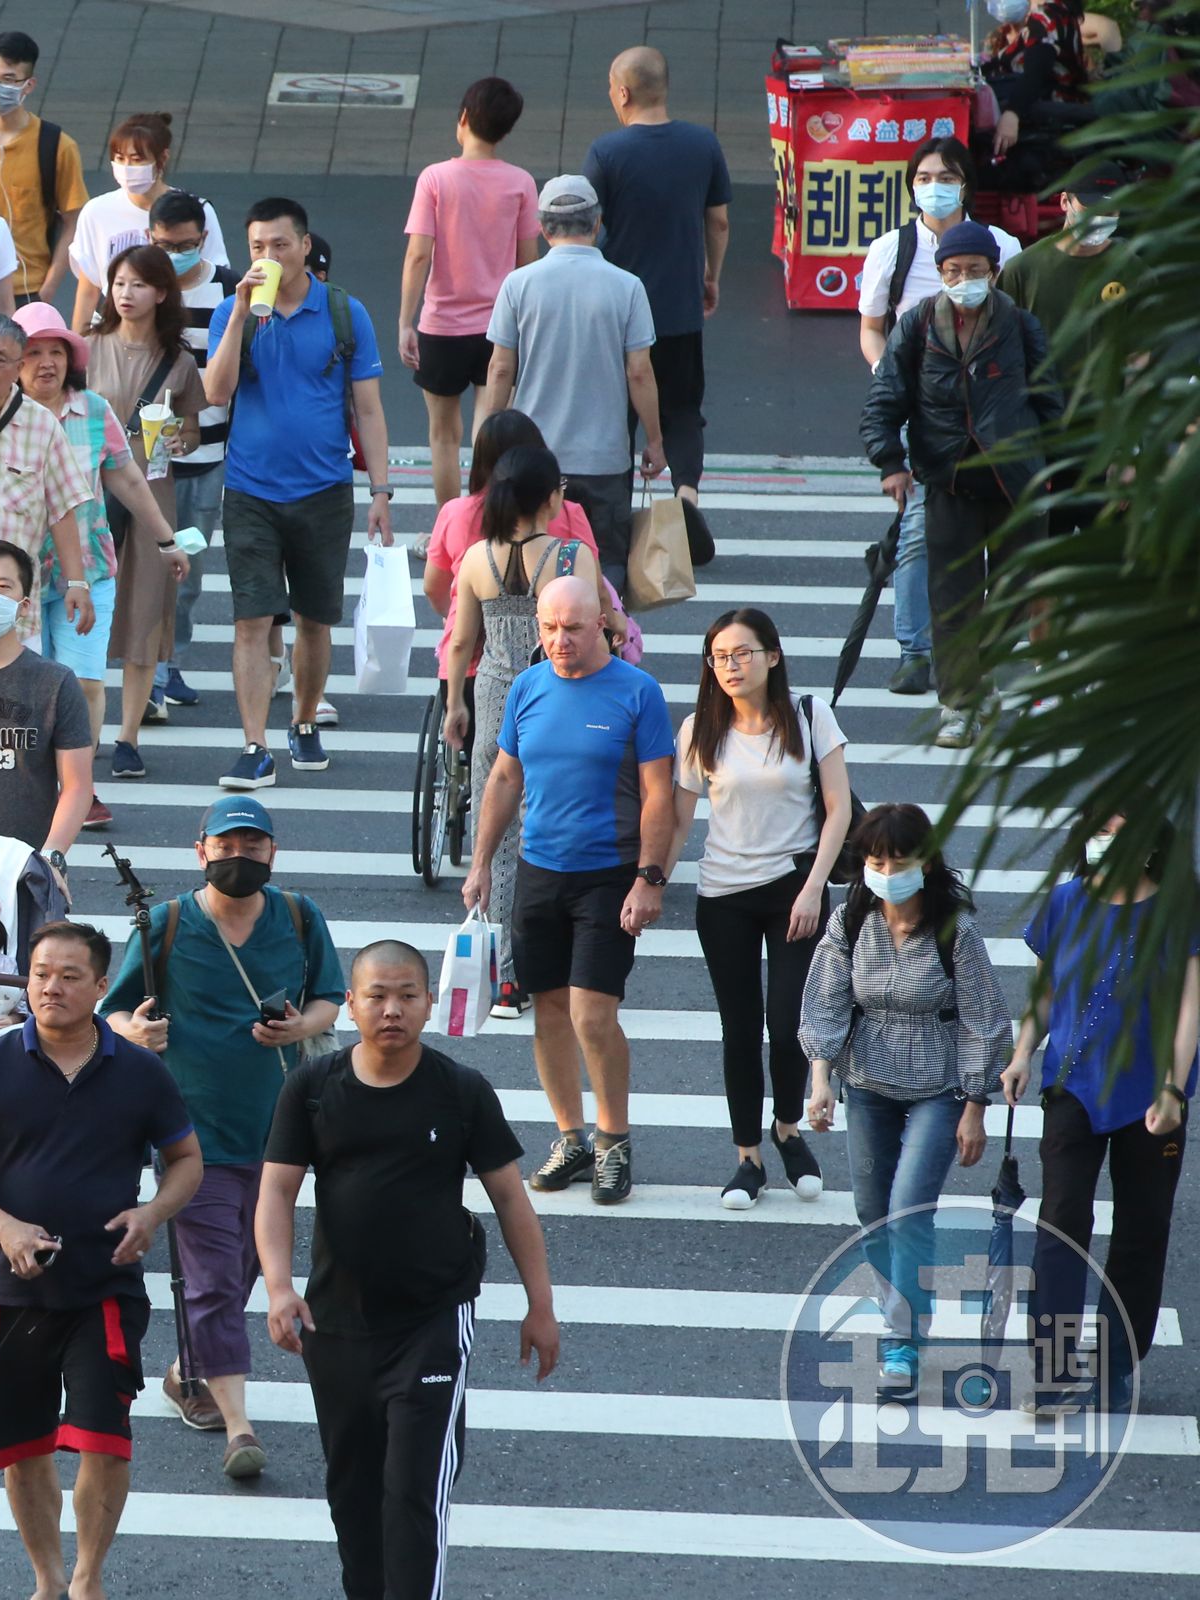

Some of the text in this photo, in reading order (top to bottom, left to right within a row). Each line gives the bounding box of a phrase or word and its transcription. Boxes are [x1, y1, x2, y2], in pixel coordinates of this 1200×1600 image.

[847, 117, 955, 142] 公益彩券
[807, 168, 917, 247] 刮刮
[421, 1374, 452, 1384] adidas
